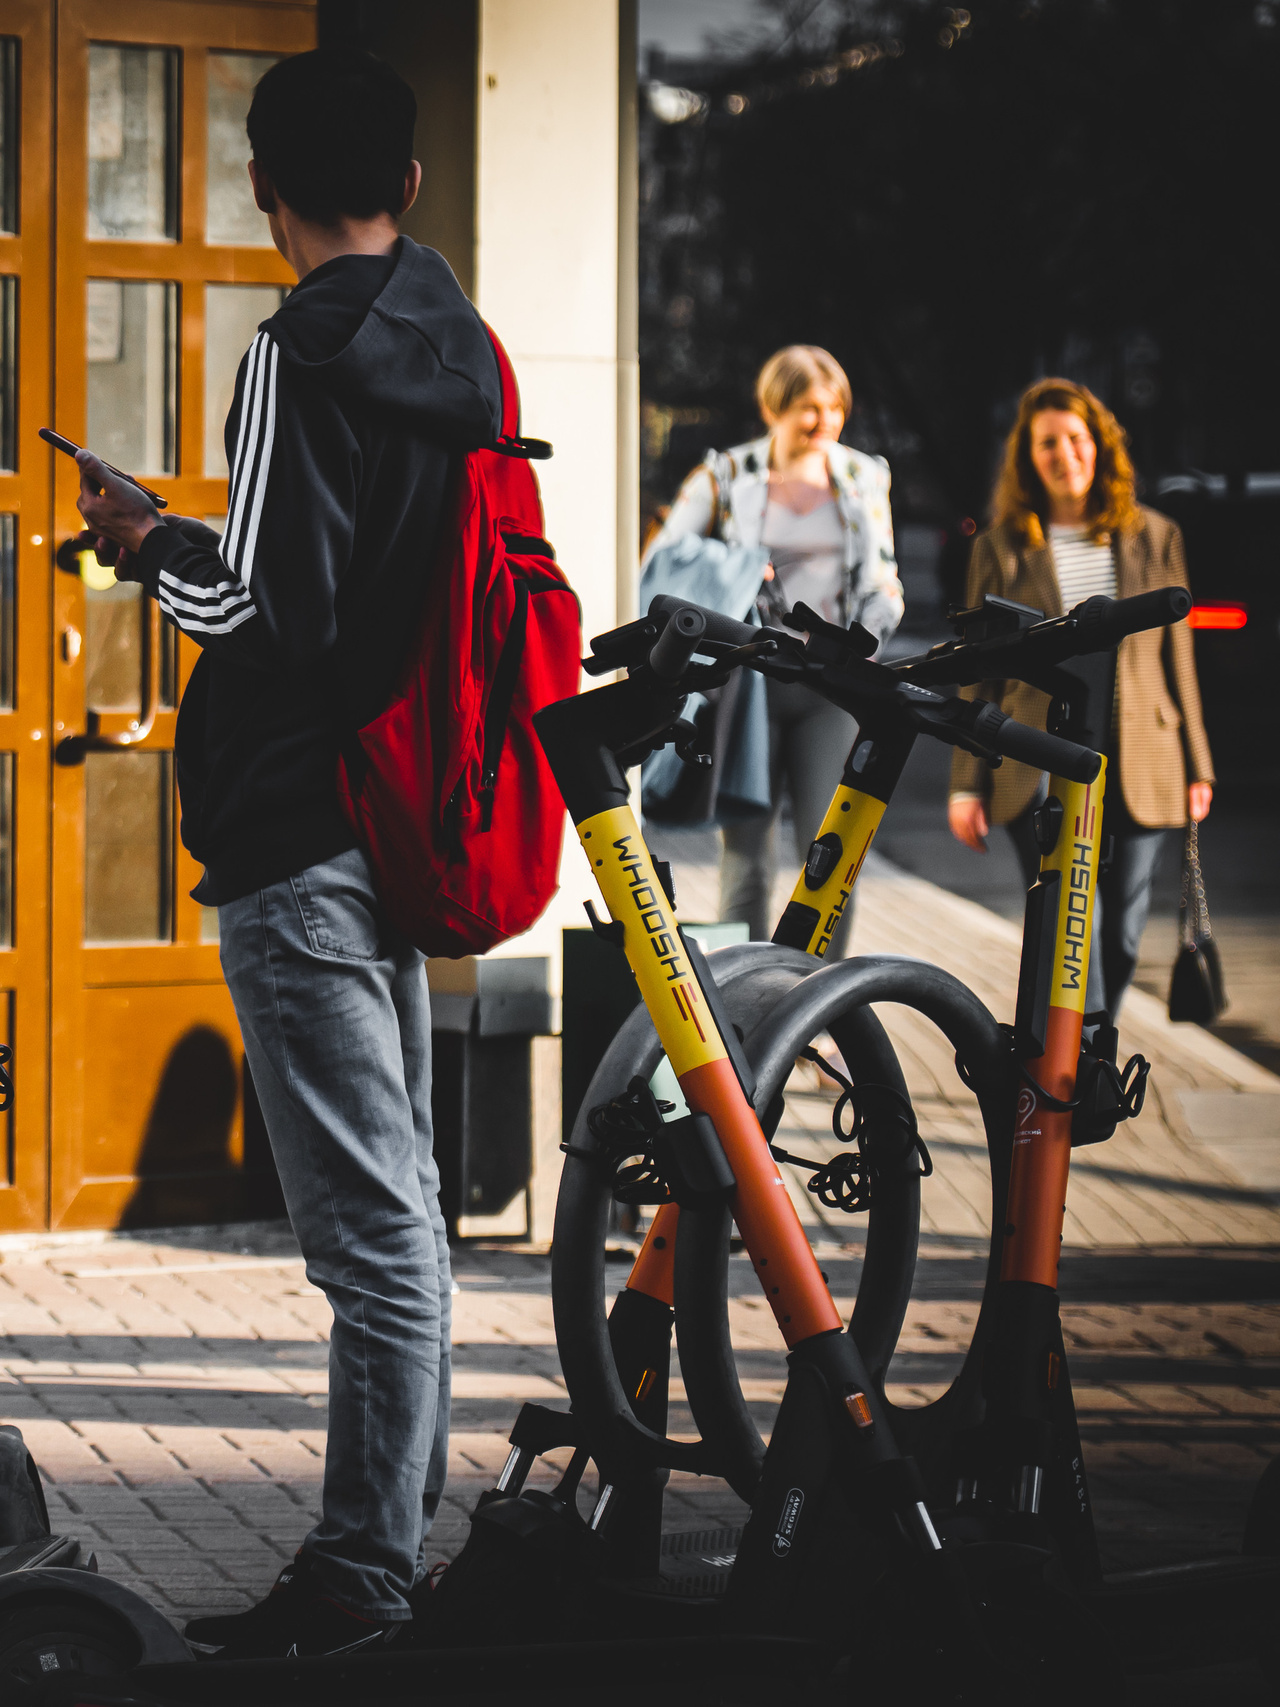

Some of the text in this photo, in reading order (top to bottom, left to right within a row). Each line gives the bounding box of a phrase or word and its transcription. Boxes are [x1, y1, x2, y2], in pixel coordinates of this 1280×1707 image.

[612, 835, 687, 982] WHOOSH
[814, 889, 850, 959] OSH
[1062, 843, 1092, 990] WHOOSH
[785, 1496, 801, 1535] SEGWAY
